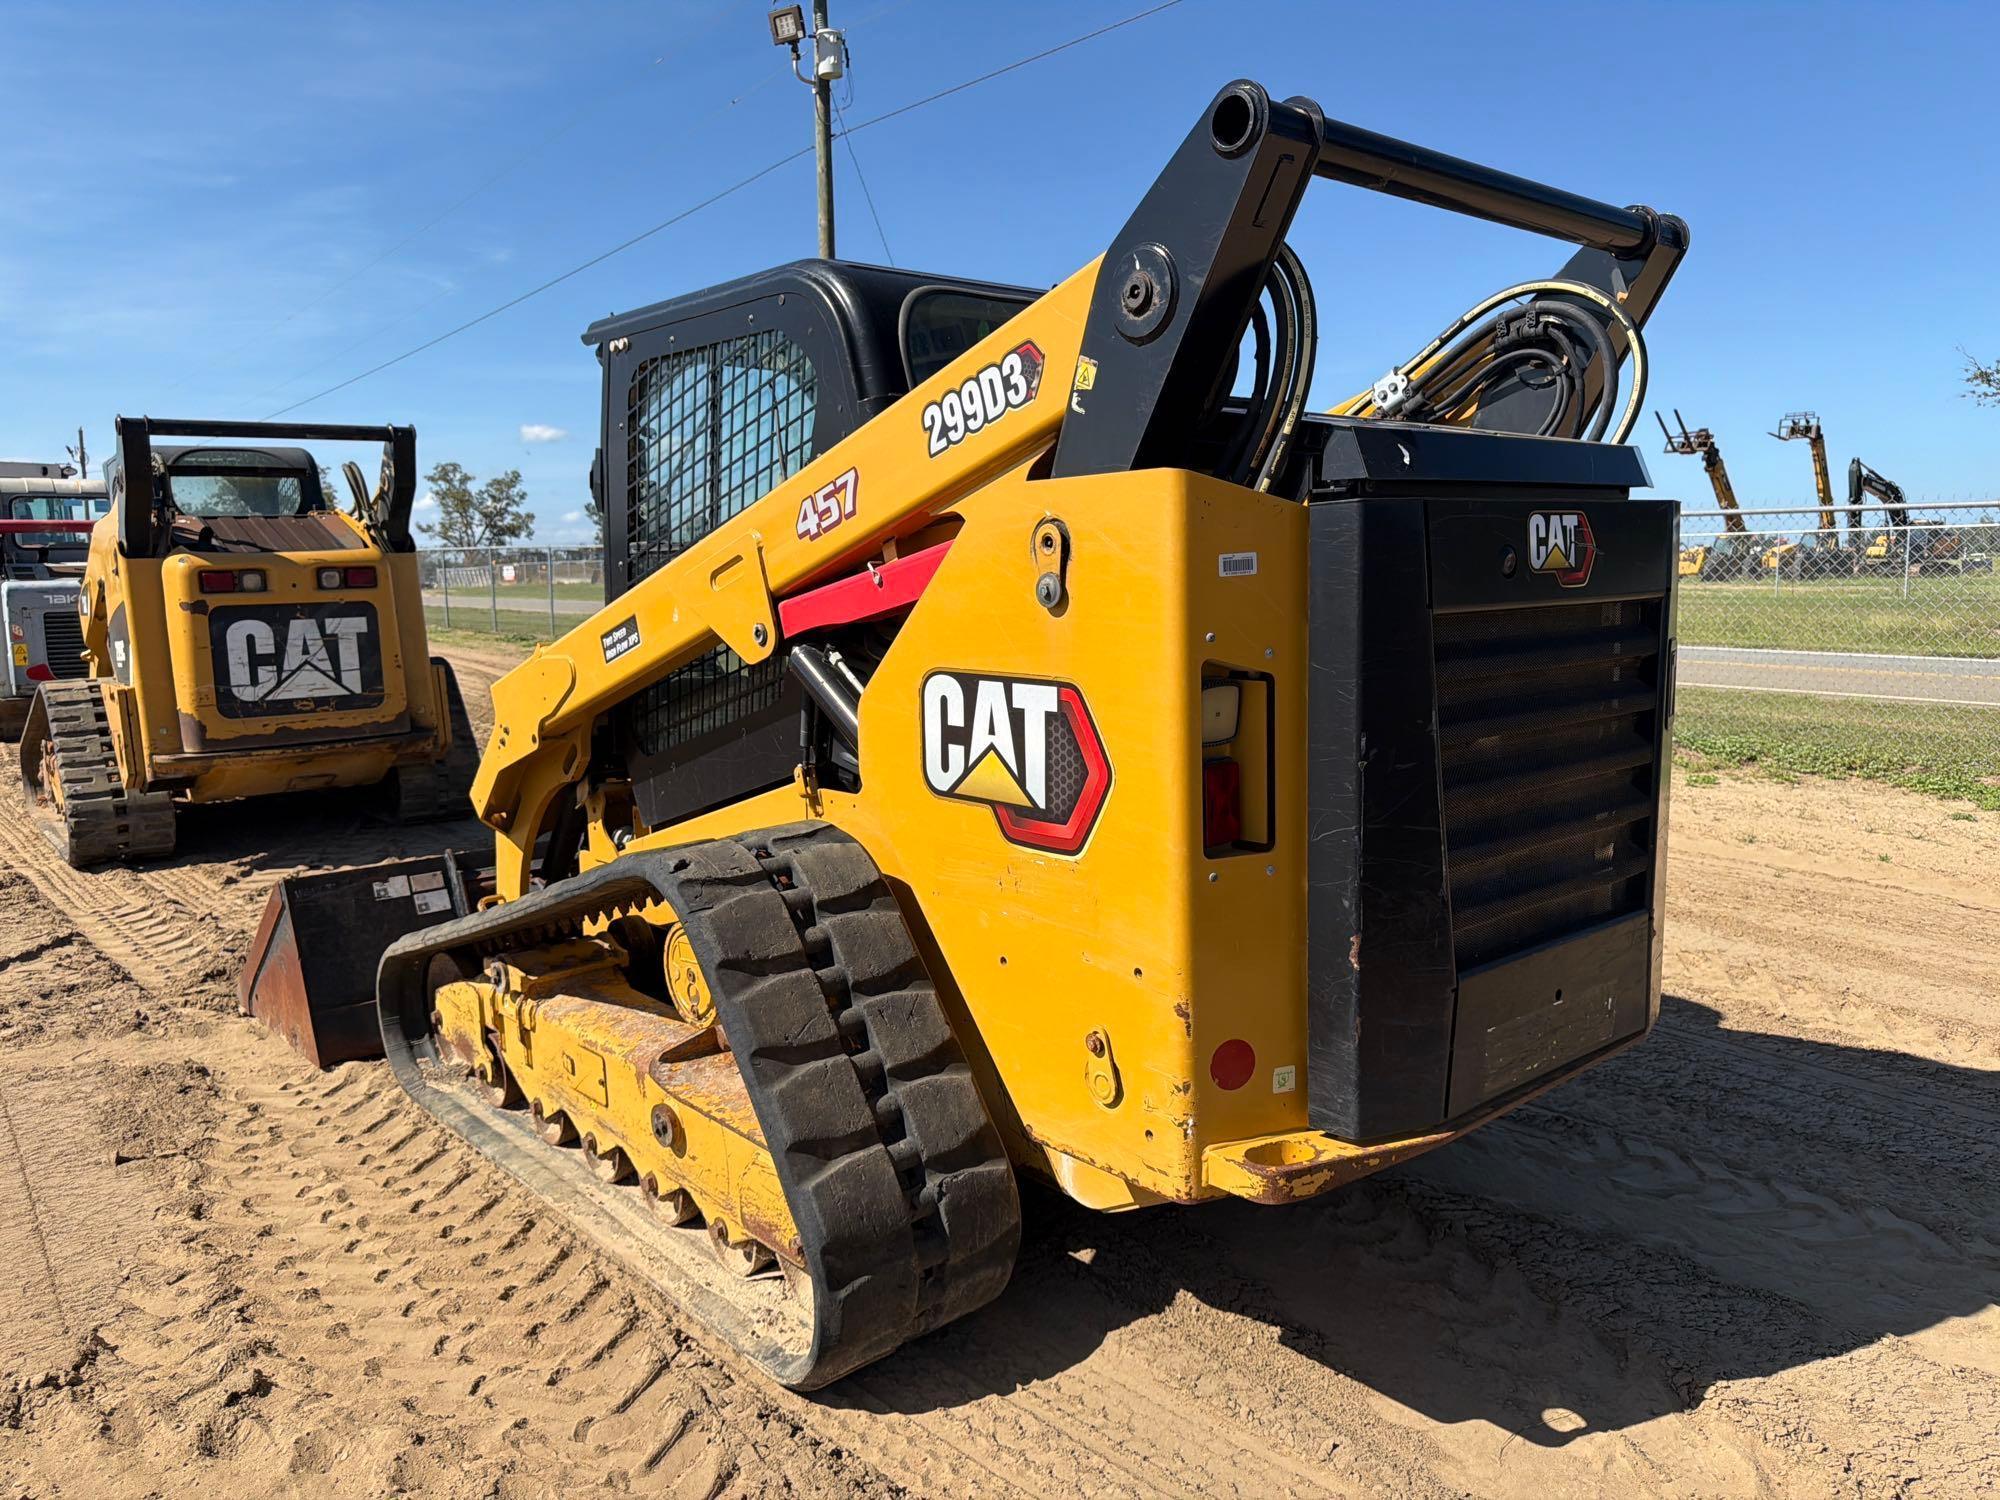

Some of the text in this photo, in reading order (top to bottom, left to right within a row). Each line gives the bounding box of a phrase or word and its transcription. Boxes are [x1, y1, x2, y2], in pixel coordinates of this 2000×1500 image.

[923, 352, 1028, 456] 299D3
[796, 466, 859, 542] 457
[1529, 513, 1579, 570] CAT
[225, 616, 369, 703] CAT
[923, 673, 1058, 810] CAT
